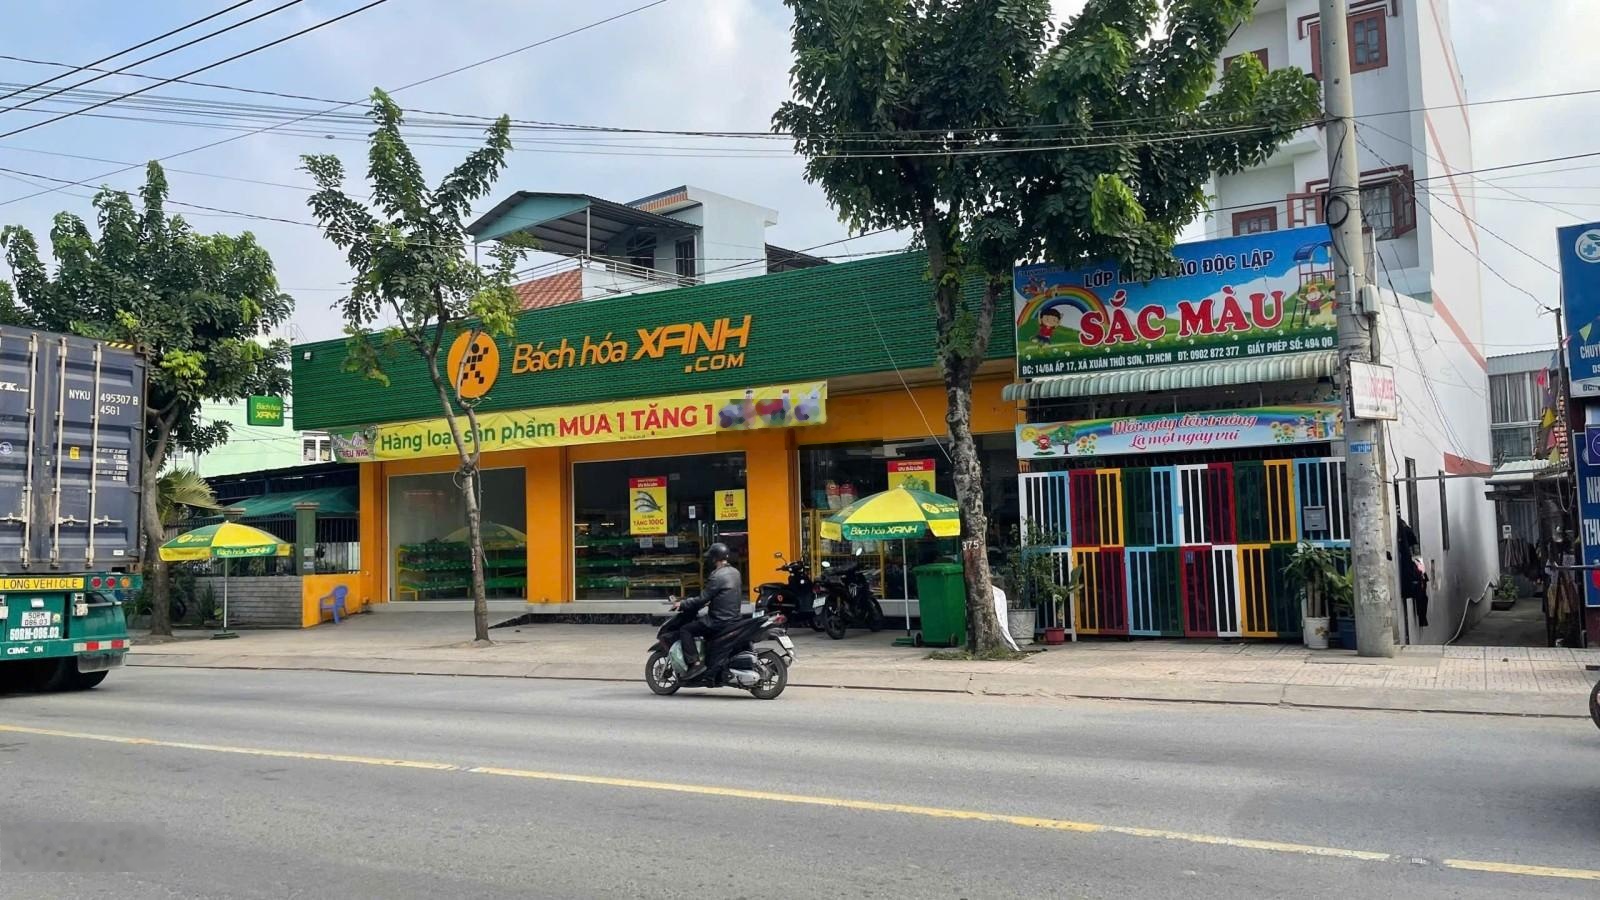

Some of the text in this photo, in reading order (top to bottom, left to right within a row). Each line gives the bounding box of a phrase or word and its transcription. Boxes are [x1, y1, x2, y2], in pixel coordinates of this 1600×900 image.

[1084, 268, 1112, 287] LỚP
[1202, 255, 1236, 276] ĐỘC
[1241, 248, 1274, 271] LẬP
[1079, 285, 1285, 347] SẮC MÀU
[511, 314, 752, 374] Bách hóa XANH
[1579, 343, 1600, 359] CHUY
[684, 352, 745, 373] .COM
[1055, 360, 1064, 372] ẤP
[1078, 359, 1088, 370] XÃ
[1089, 357, 1108, 369] XUÂN
[1110, 355, 1126, 367] THỜI
[1146, 352, 1172, 363] TP.HCM
[1190, 350, 1208, 360] 0902
[1210, 348, 1224, 358] 872
[1225, 346, 1240, 357] 377
[1247, 340, 1265, 355] GIẤY
[1266, 340, 1288, 353] PHÉP
[1304, 338, 1320, 349] 494
[69, 389, 91, 400] NYKU
[100, 393, 130, 405] 495307
[100, 405, 120, 416] 45G1
[381, 430, 422, 453] Hàng
[427, 429, 456, 450] loạ
[501, 416, 555, 444] phẩm
[559, 413, 612, 437] MUA
[616, 412, 625, 433] 1
[631, 404, 698, 436] TẶNG
[704, 404, 713, 425] 1
[850, 525, 870, 535] Bách
[886, 525, 917, 534] XANH
[962, 540, 979, 551] 375
[3, 578, 78, 590] LONG VEHICLE
